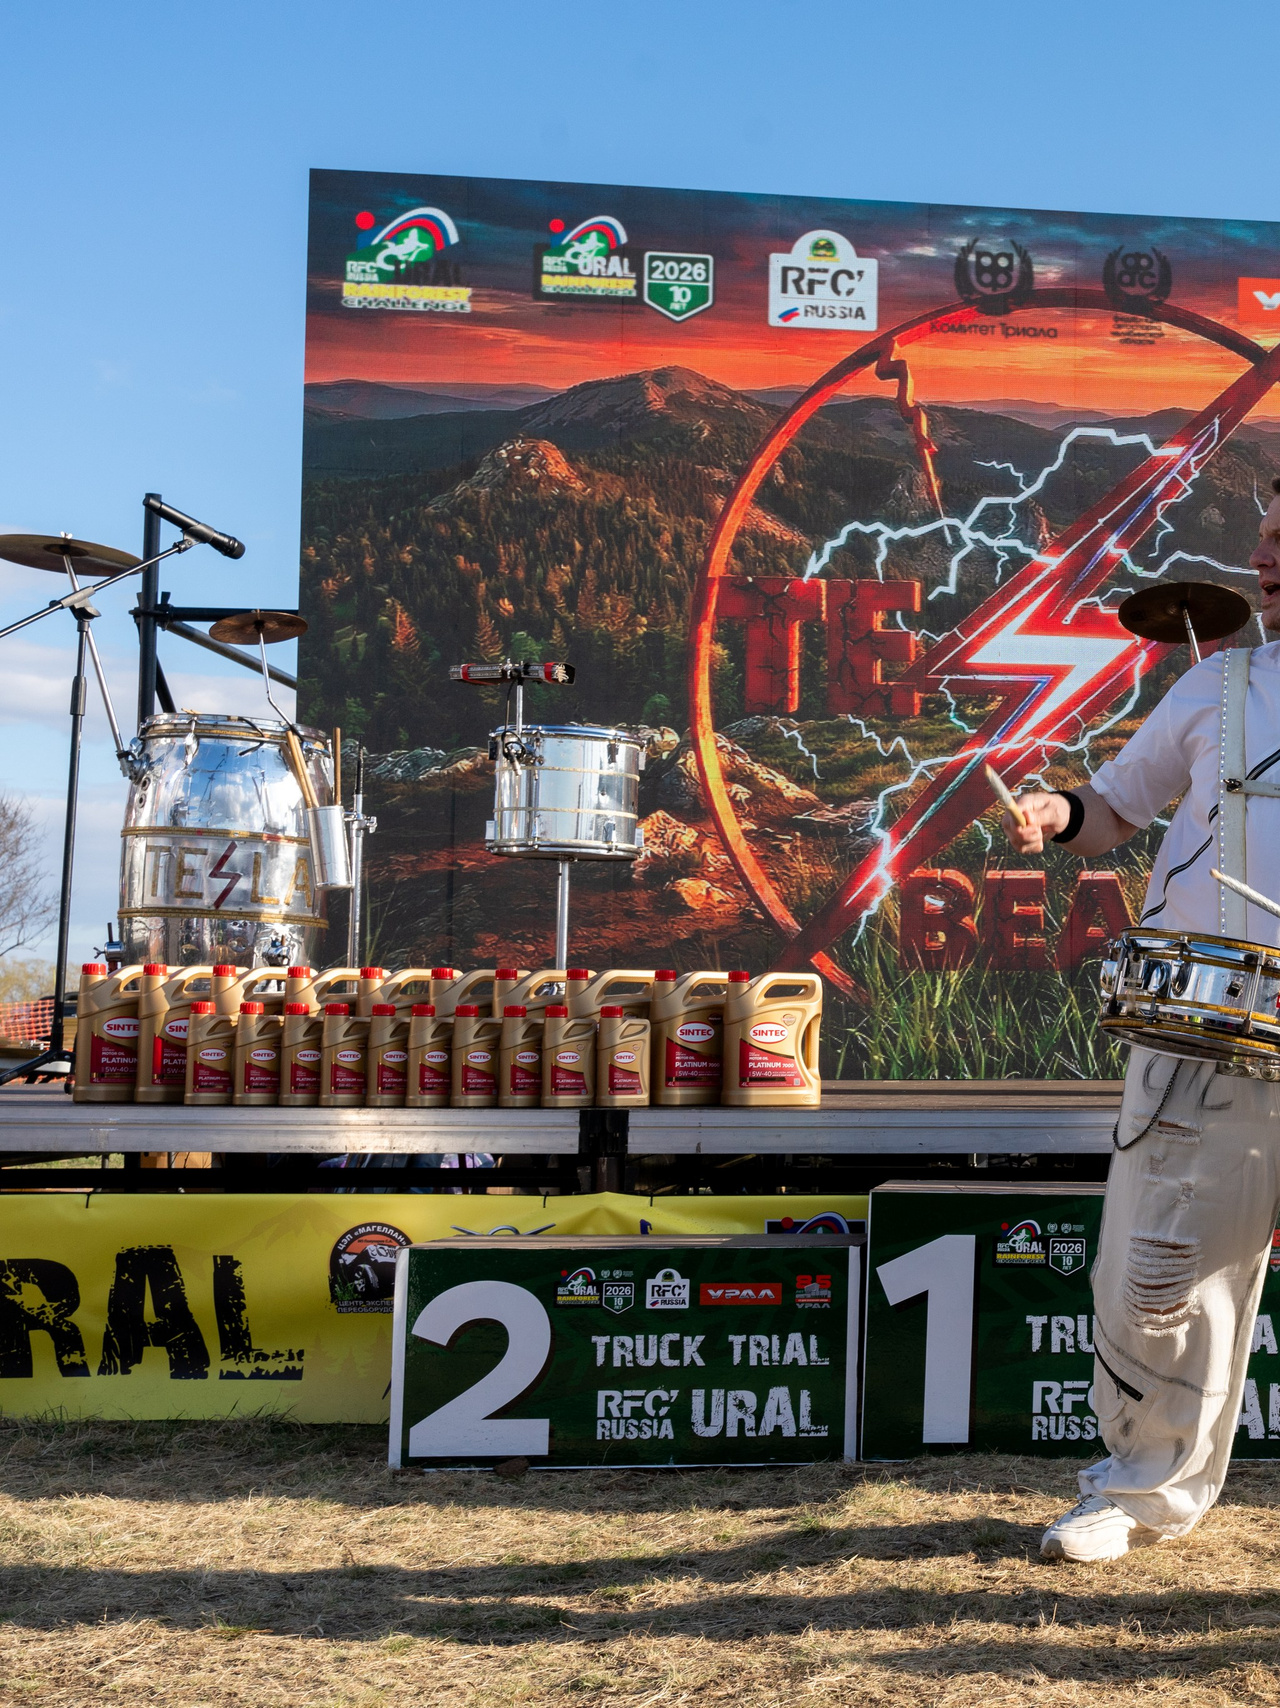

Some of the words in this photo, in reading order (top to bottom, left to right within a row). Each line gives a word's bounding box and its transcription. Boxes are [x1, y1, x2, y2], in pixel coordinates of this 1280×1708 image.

[346, 261, 377, 273] RFC
[578, 256, 636, 277] URAL
[651, 260, 707, 281] 2026
[669, 286, 691, 303] 10
[804, 305, 866, 320] RUSSIA
[900, 867, 1142, 972] BEA
[752, 1029, 785, 1037] SINTEC
[337, 1234, 353, 1250] ЦЭП
[1015, 1241, 1045, 1253] URAL
[1053, 1242, 1082, 1253] 2026
[1062, 1256, 1073, 1266] 10
[796, 1274, 832, 1289] 85
[573, 1285, 599, 1295] URAL
[606, 1286, 632, 1295] 2026
[707, 1289, 775, 1299] УРАЛ
[613, 1297, 623, 1306] 10
[0, 1245, 304, 1380] RAL
[875, 1234, 976, 1444] 1
[1025, 1315, 1096, 1353] TRU
[591, 1333, 706, 1367] TRUCK
[728, 1332, 830, 1366] TRIAL
[409, 1280, 551, 1458] 2
[690, 1385, 829, 1438] URAL
[596, 1418, 674, 1440] RUSSIA
